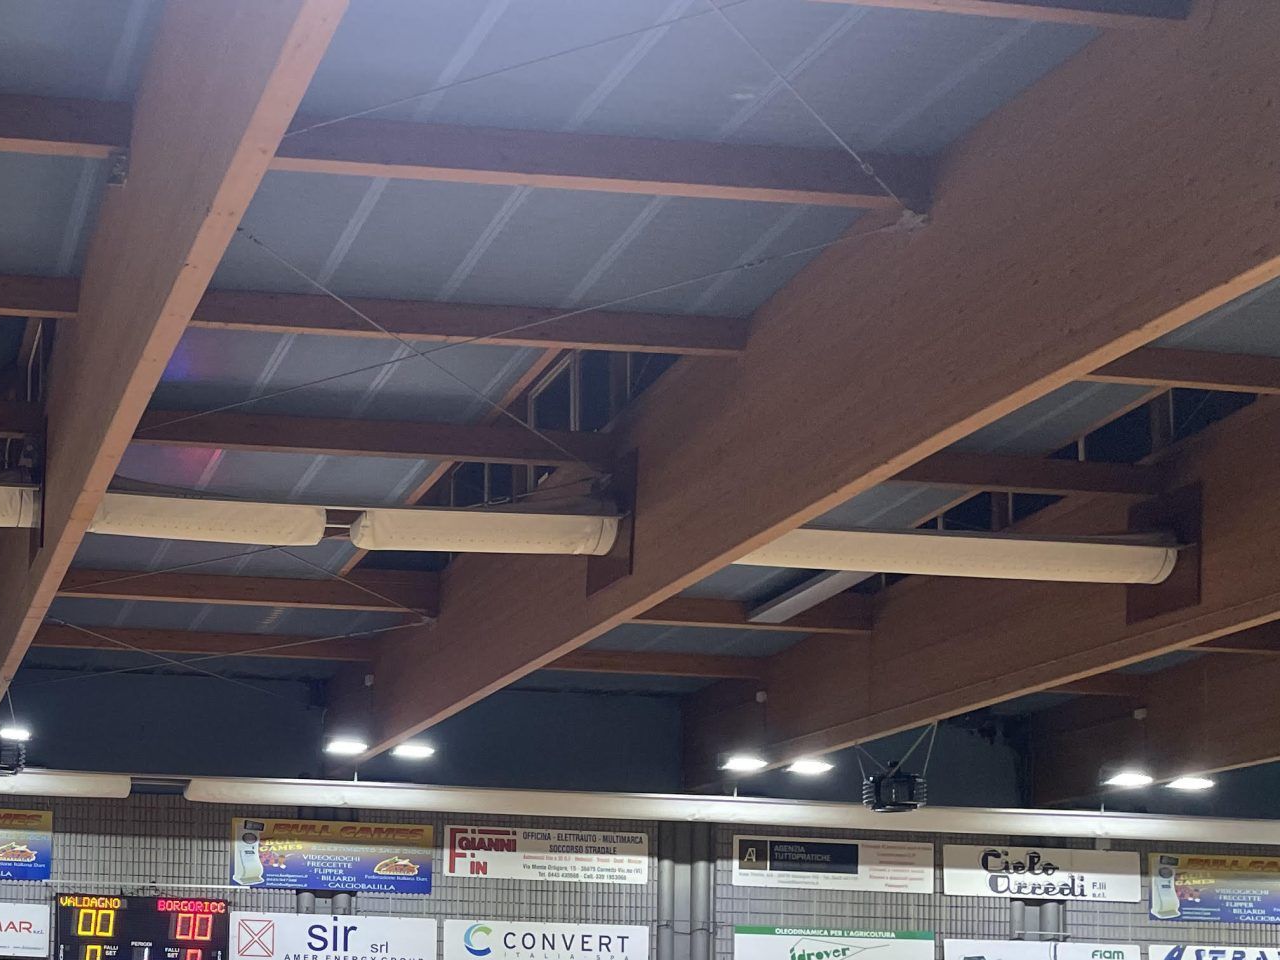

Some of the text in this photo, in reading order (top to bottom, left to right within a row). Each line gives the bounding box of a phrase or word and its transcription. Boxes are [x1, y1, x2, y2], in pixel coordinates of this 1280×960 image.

[60, 896, 120, 908] VALDAGNO
[158, 901, 225, 913] BORGORICC
[78, 909, 114, 937] 00
[176, 914, 213, 940] 00
[307, 916, 388, 954] sir srl
[504, 932, 629, 952] CONVERT
